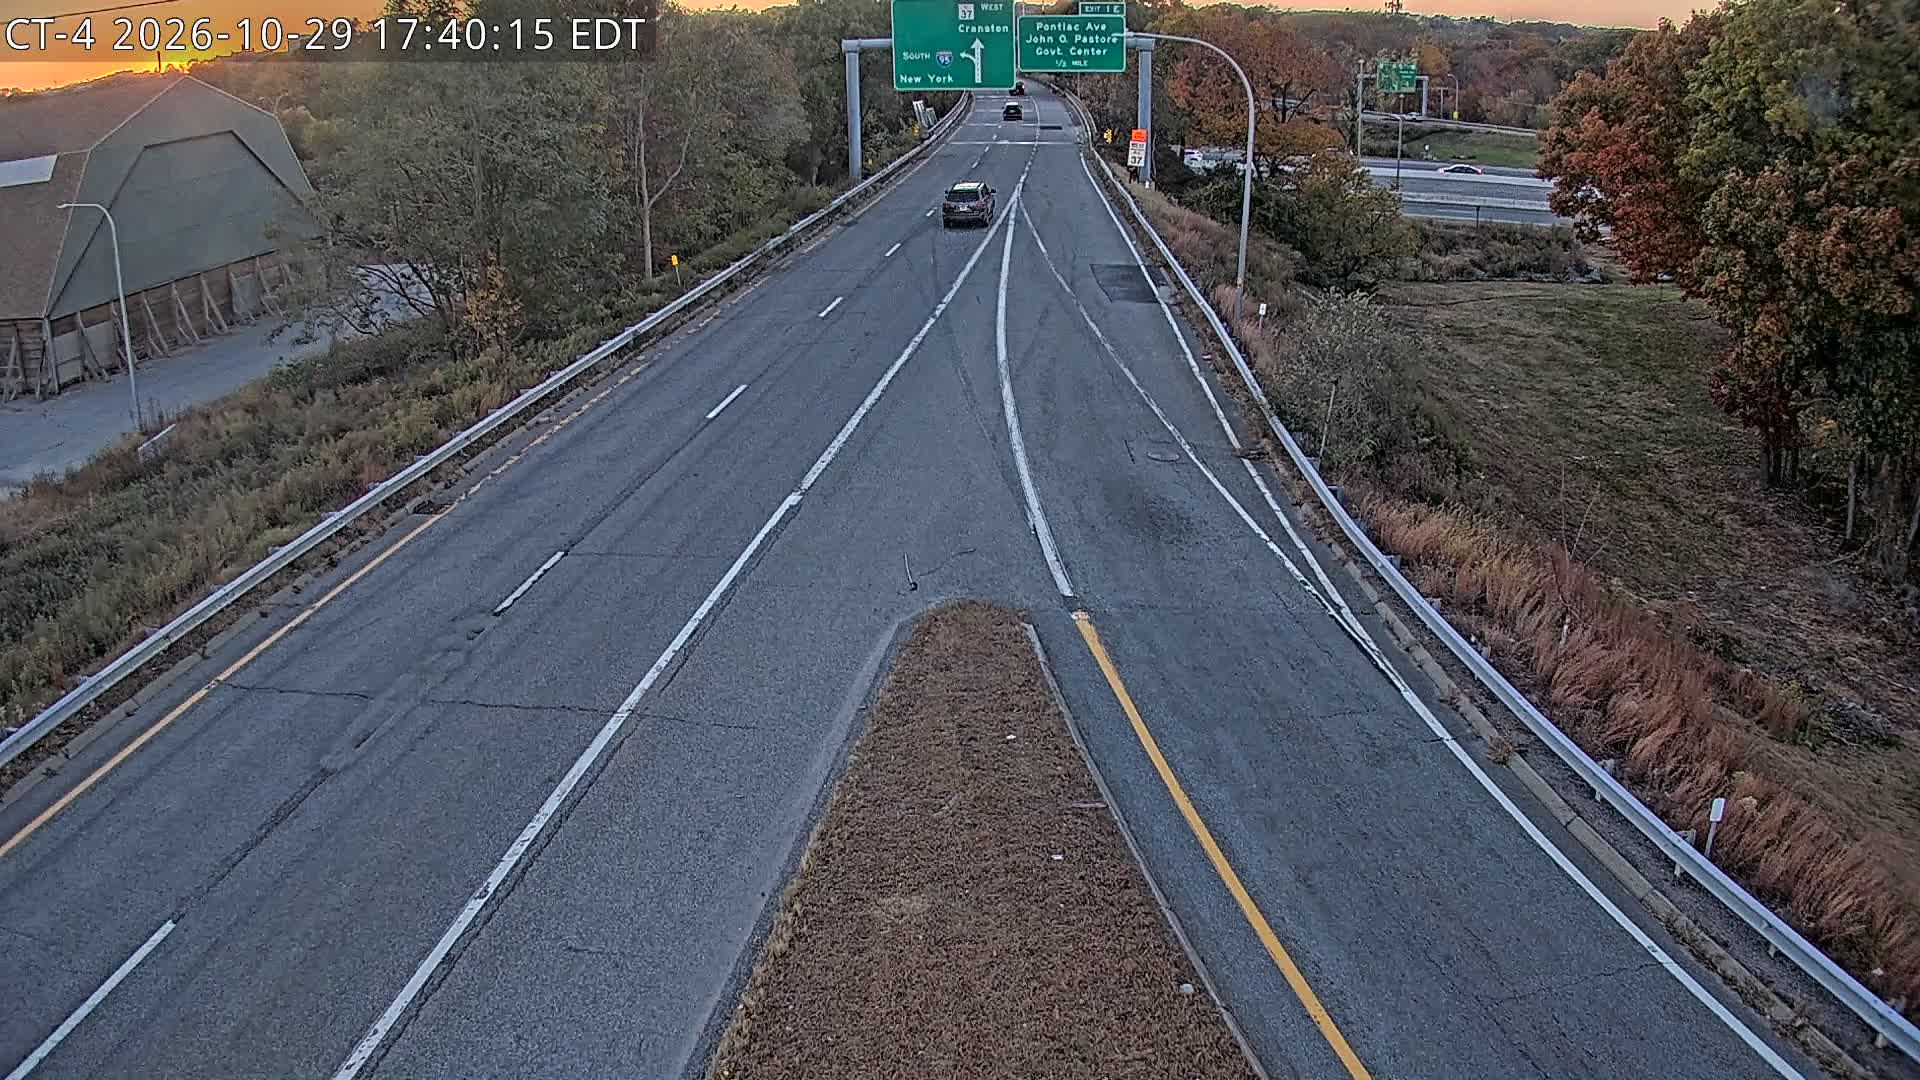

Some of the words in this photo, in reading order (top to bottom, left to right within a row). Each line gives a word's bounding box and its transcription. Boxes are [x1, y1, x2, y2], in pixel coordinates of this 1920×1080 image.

[1084, 5, 1100, 13] EXIT
[960, 10, 972, 19] 37
[958, 24, 1009, 33] Cranston
[1036, 22, 1080, 31] Pontiac
[1085, 22, 1107, 31] Ave
[1025, 34, 1054, 44] John
[1074, 34, 1119, 44] Pastore
[902, 51, 931, 60] SOUTH
[1069, 46, 1108, 56] Center
[939, 56, 951, 64] 95
[899, 74, 922, 84] New
[927, 74, 954, 84] York
[1130, 155, 1142, 165] 37
